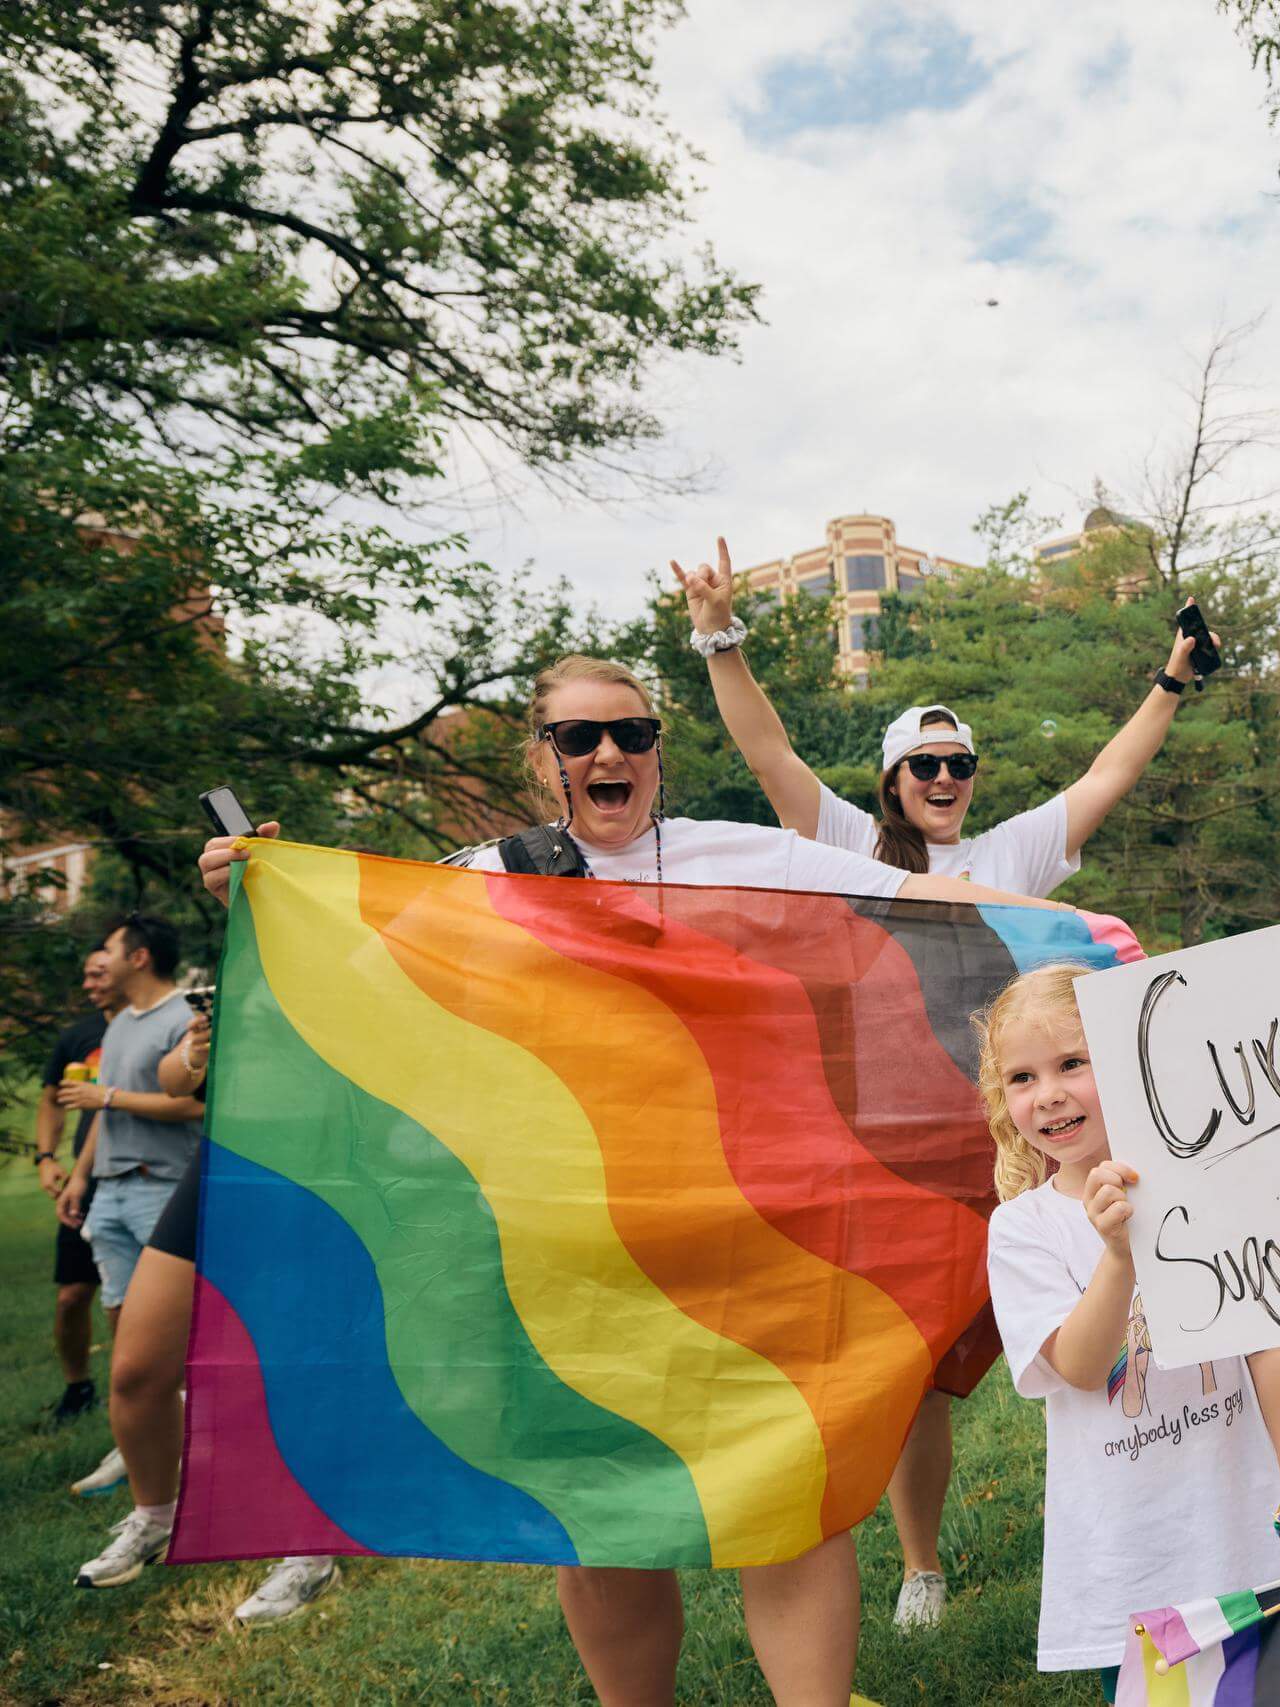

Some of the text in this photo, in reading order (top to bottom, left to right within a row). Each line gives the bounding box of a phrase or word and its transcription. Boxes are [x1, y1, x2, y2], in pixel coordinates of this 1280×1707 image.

[1104, 1389, 1244, 1461] anybody less gay
